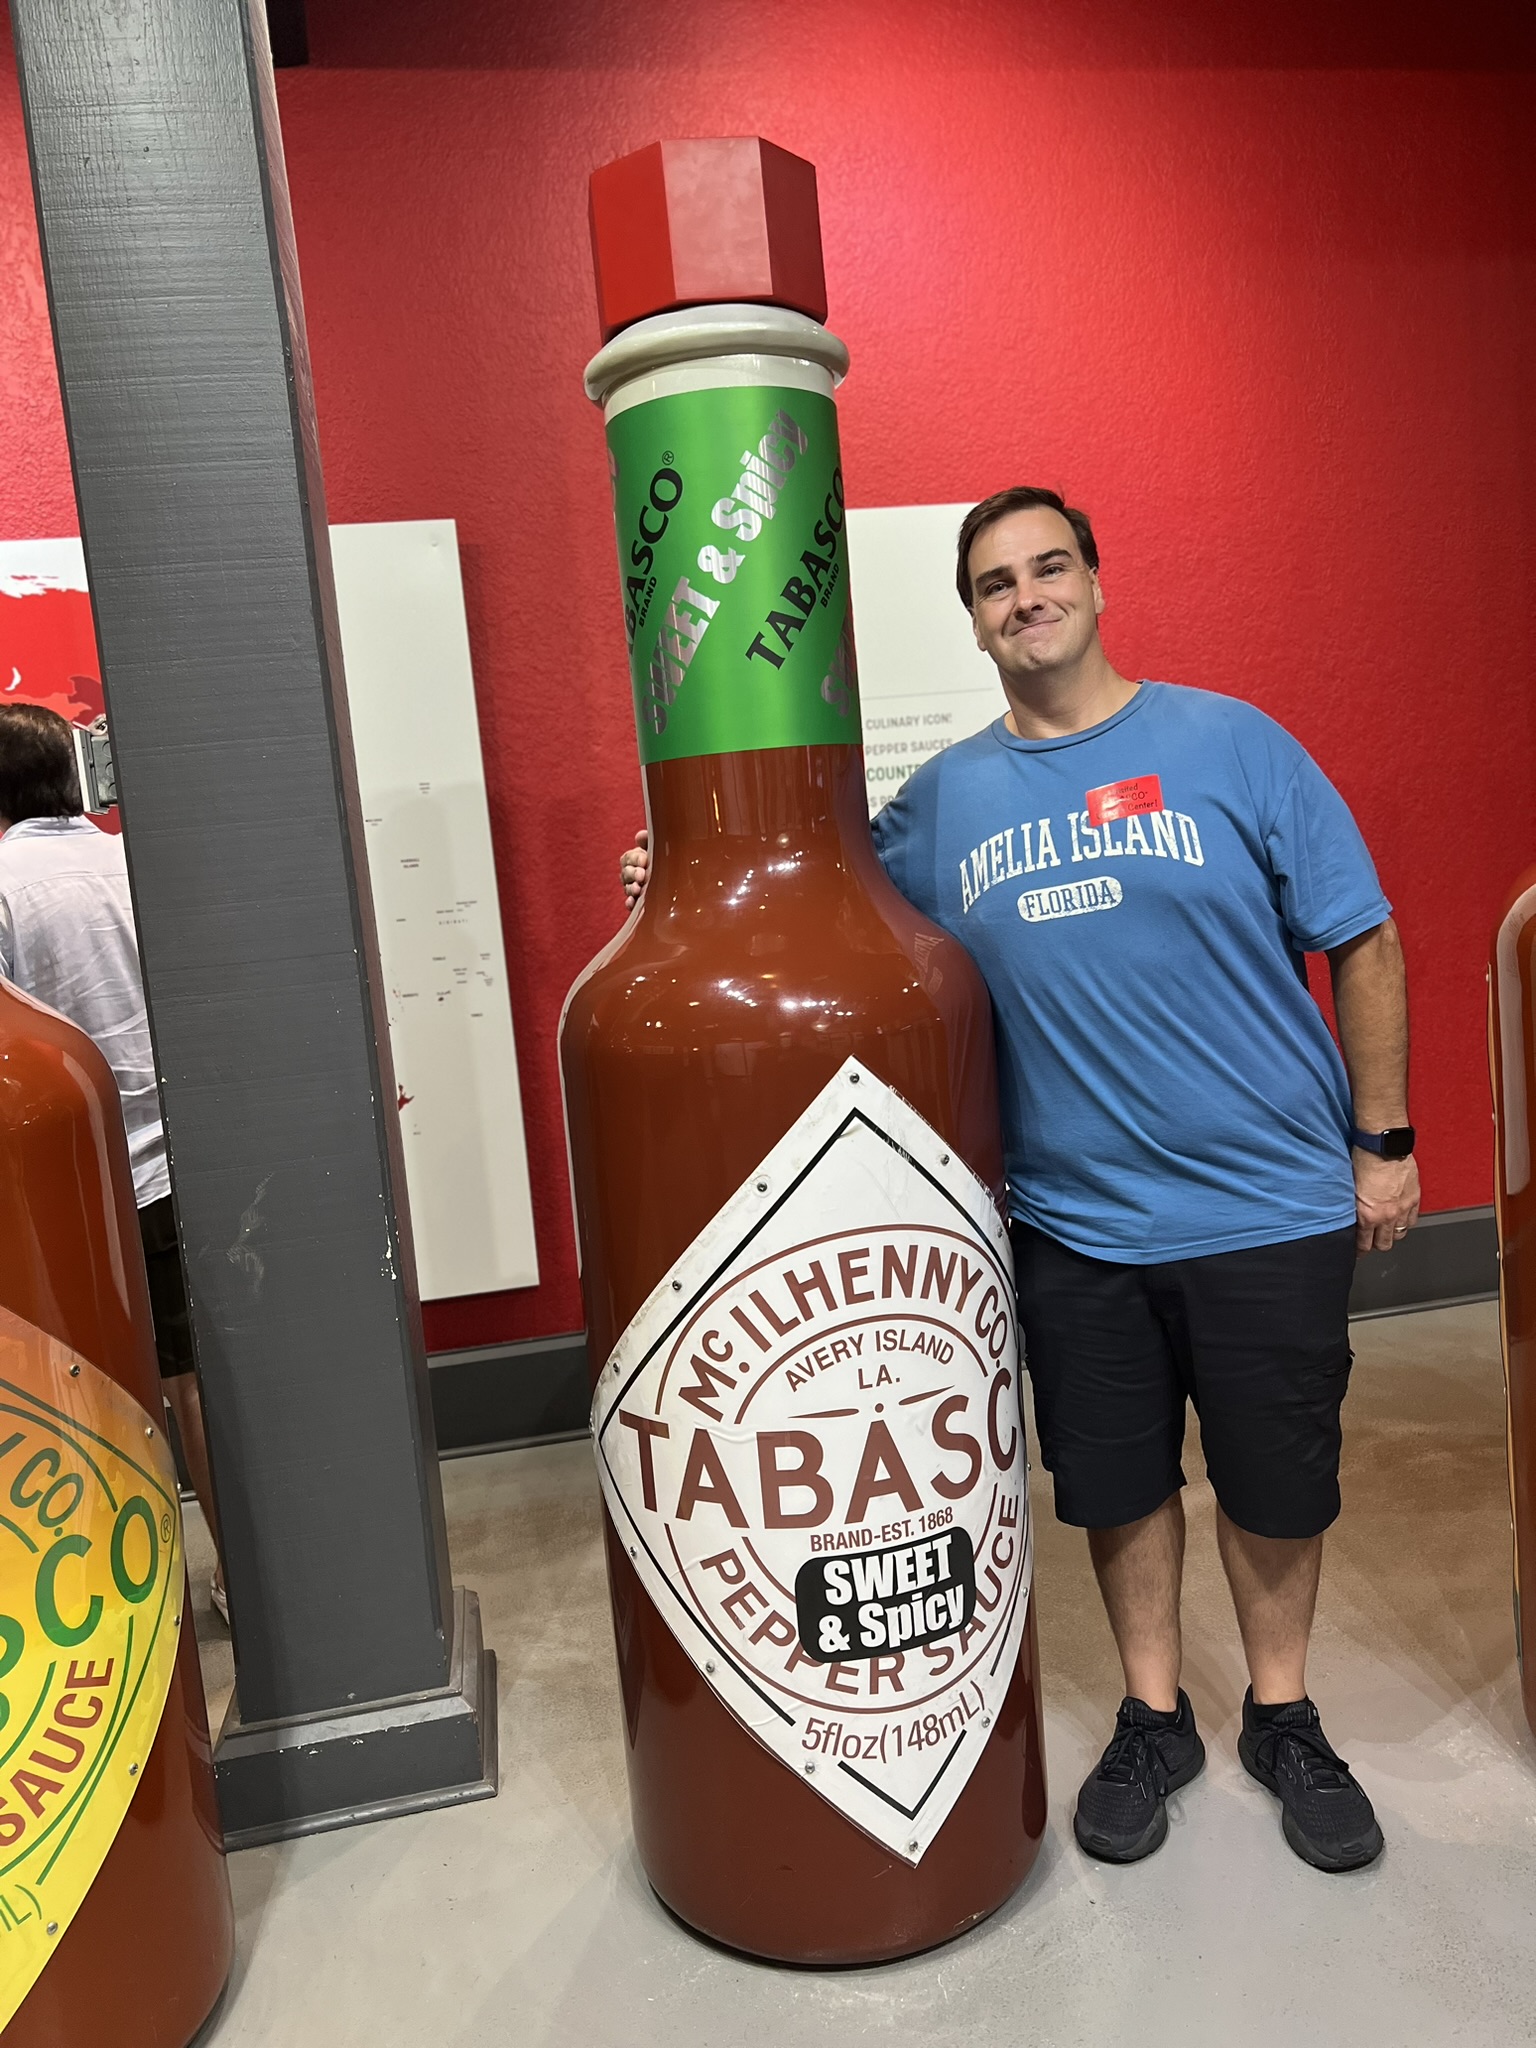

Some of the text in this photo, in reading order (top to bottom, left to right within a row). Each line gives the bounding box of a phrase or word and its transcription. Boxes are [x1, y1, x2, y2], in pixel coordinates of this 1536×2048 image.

[641, 408, 809, 735] SWEET & Spicy
[820, 562, 841, 609] BRAND
[638, 576, 658, 628] BRAND
[865, 716, 920, 731] CULINARY
[865, 742, 908, 756] PEPPER
[1127, 799, 1159, 812] Center!
[959, 808, 1205, 914] AMELIA ISLAND
[1023, 880, 1117, 919] FLORIDA
[784, 1328, 954, 1392] AVERY ISLAND
[857, 1363, 901, 1390] LA.
[618, 1366, 1026, 1530] TABASC
[10, 1448, 84, 1537] CO.
[810, 1507, 954, 1552] BRAND-EST. 1868
[822, 1534, 953, 1606] SWEET
[922, 1494, 1019, 1677] SAUCE
[818, 1584, 965, 1653] & Spicy
